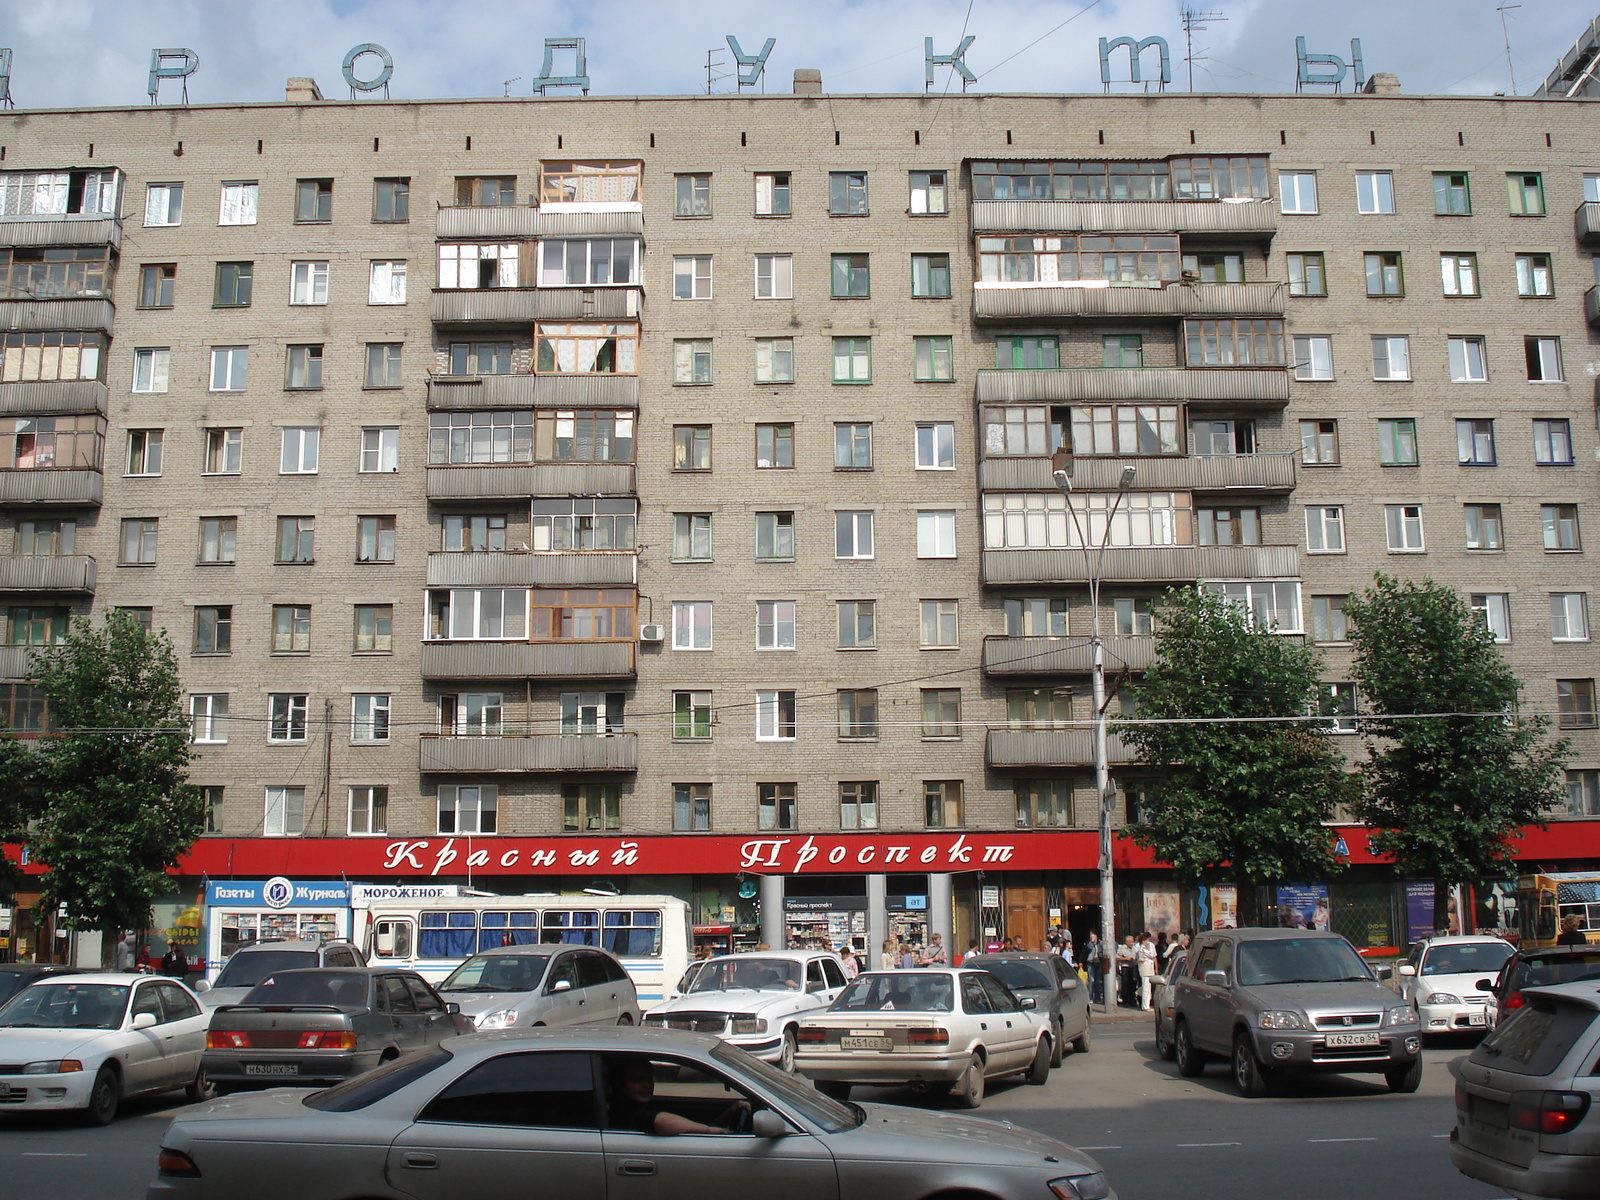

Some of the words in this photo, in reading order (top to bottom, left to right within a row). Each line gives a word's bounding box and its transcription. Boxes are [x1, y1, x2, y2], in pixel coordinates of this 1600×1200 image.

[0, 35, 1365, 100] РОДУКТЫ
[383, 838, 639, 876] Красный
[740, 834, 1014, 873] Проспект
[215, 886, 255, 899] Газеты
[296, 887, 349, 900] Журналы
[363, 888, 445, 898] МОРОЖЕНОЕ
[165, 928, 199, 937] СЫРЫ
[843, 1038, 879, 1049] М451СЕ
[1330, 1034, 1366, 1045] Х632СВ
[249, 1064, 283, 1074] Н630НХ
